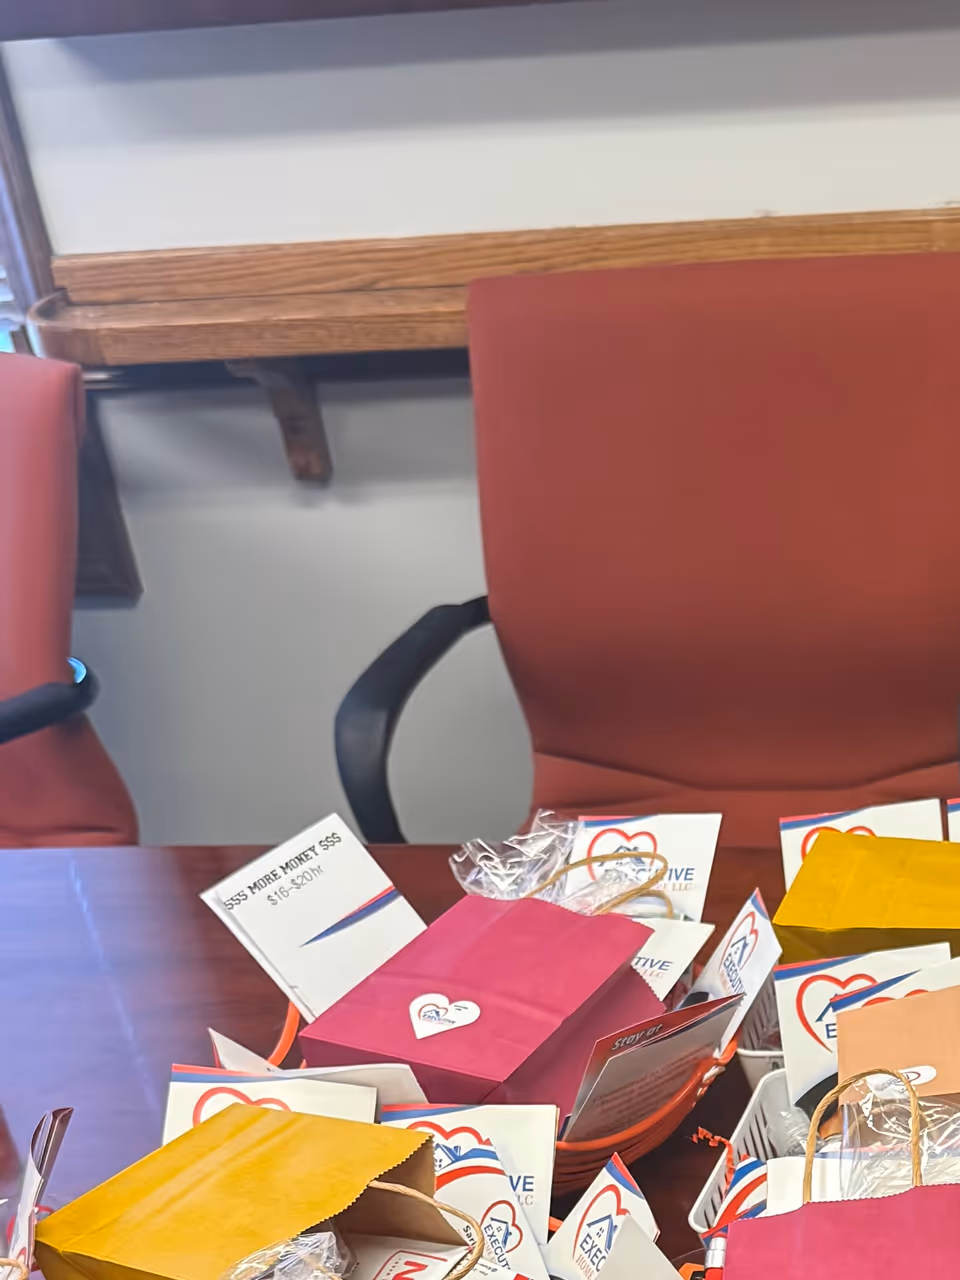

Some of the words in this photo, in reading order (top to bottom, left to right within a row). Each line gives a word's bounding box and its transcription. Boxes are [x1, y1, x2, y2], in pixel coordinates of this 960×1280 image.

[247, 868, 282, 896] MORE
[279, 845, 319, 875] MONEY
[463, 1224, 477, 1247] Sari
